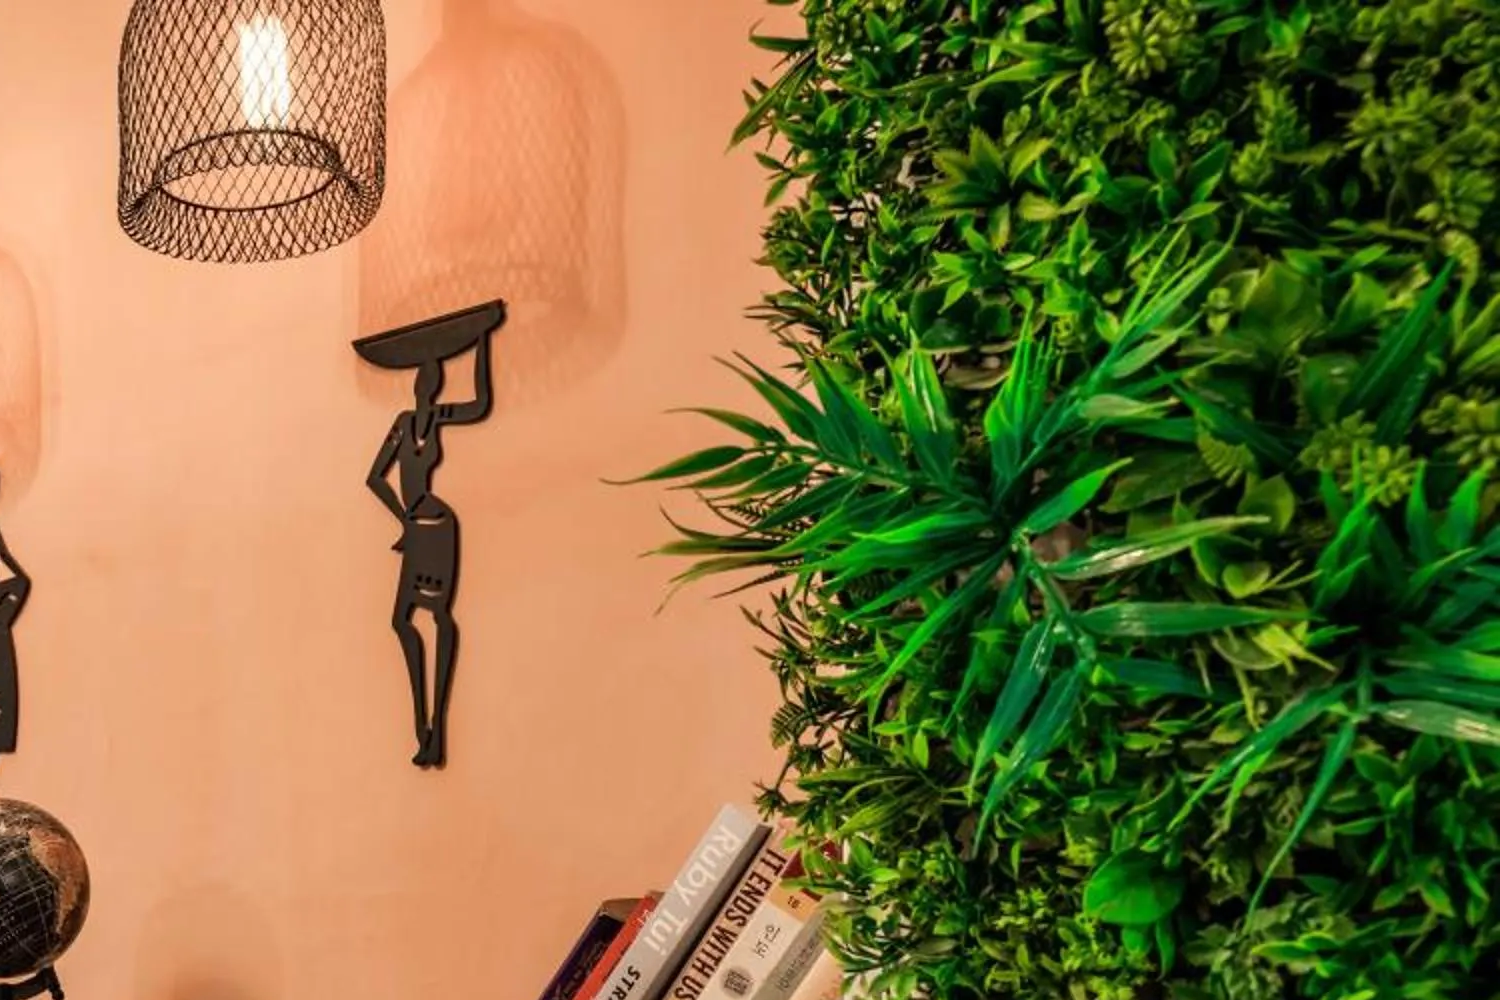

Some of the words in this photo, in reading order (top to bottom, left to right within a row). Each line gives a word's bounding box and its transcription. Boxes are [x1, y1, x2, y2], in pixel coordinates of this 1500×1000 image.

[674, 825, 742, 906] Ruby
[760, 848, 788, 877] IT
[725, 871, 773, 928] ENDS
[643, 910, 688, 956] Tui
[692, 925, 739, 979] WITH
